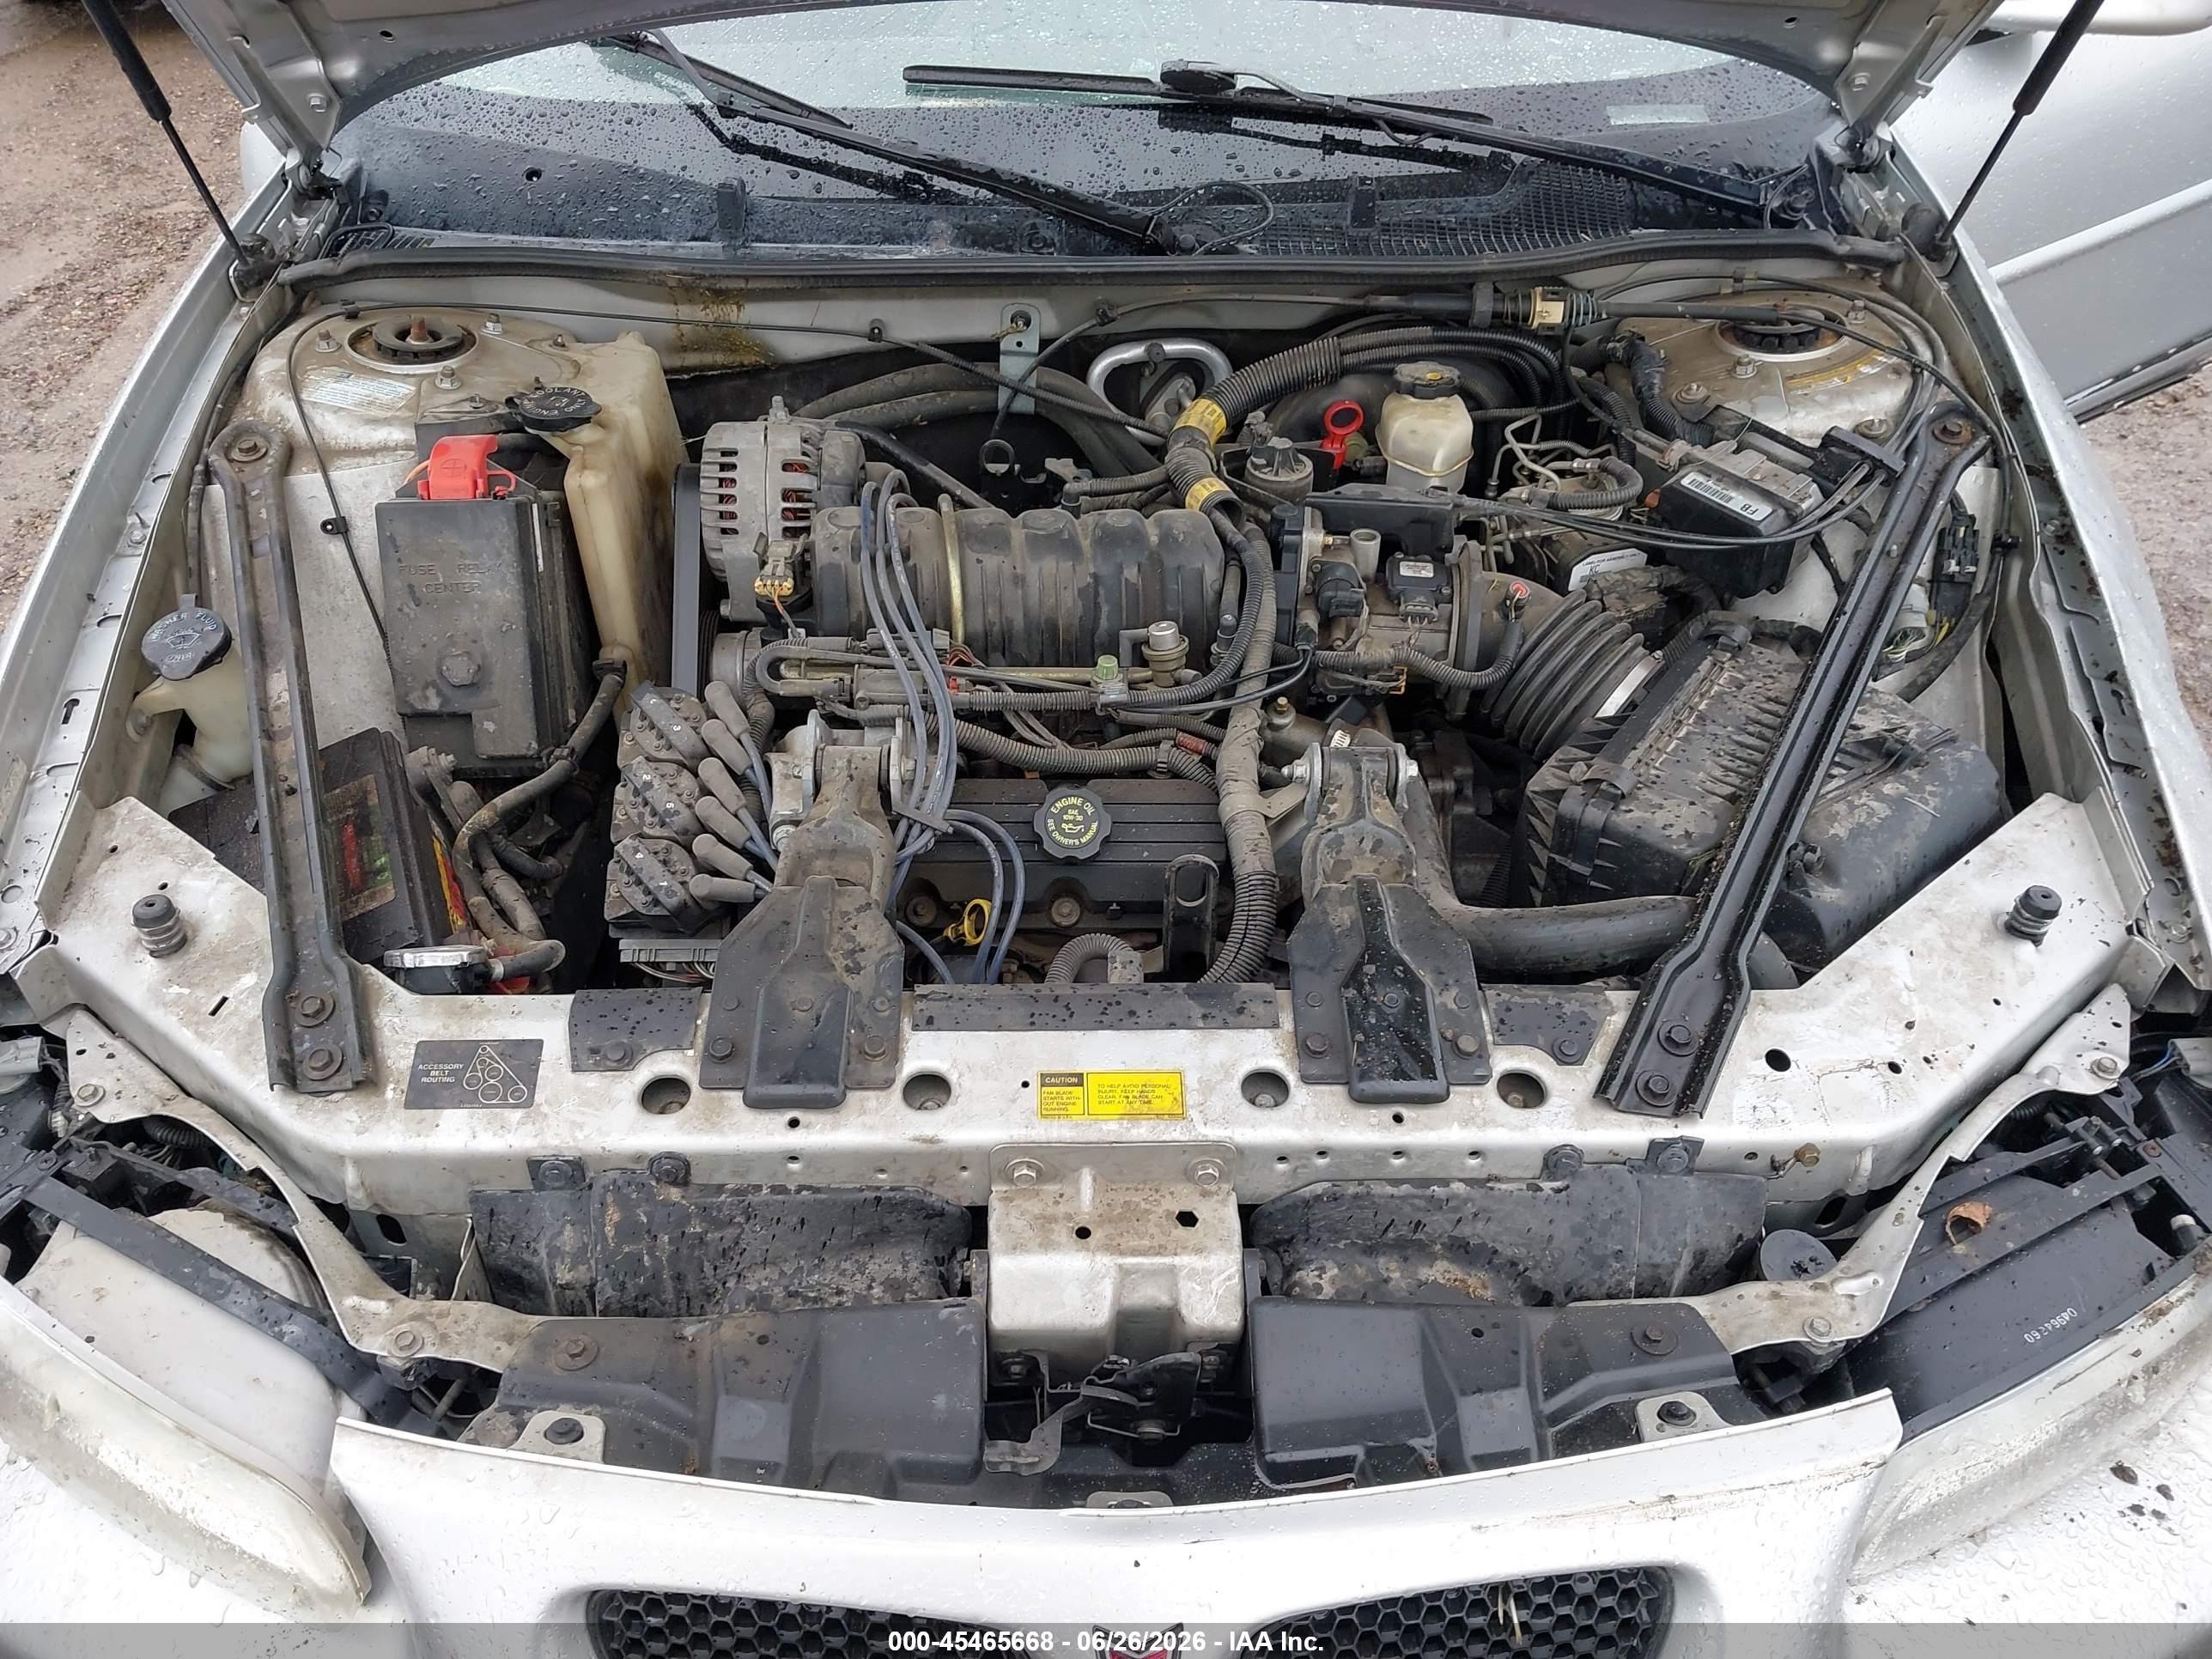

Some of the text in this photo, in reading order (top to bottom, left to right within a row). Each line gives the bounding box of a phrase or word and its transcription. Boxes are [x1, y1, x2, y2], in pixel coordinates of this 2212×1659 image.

[529, 387, 586, 398] COOLANT
[1740, 503, 1759, 515] FB
[398, 563, 437, 575] FUSE
[424, 581, 482, 593] CENTER
[195, 612, 218, 630] FLUID
[1051, 797, 1097, 816] ENGINE OIL
[1052, 830, 1080, 846] OWNER'S
[1079, 820, 1098, 843] MANUAL
